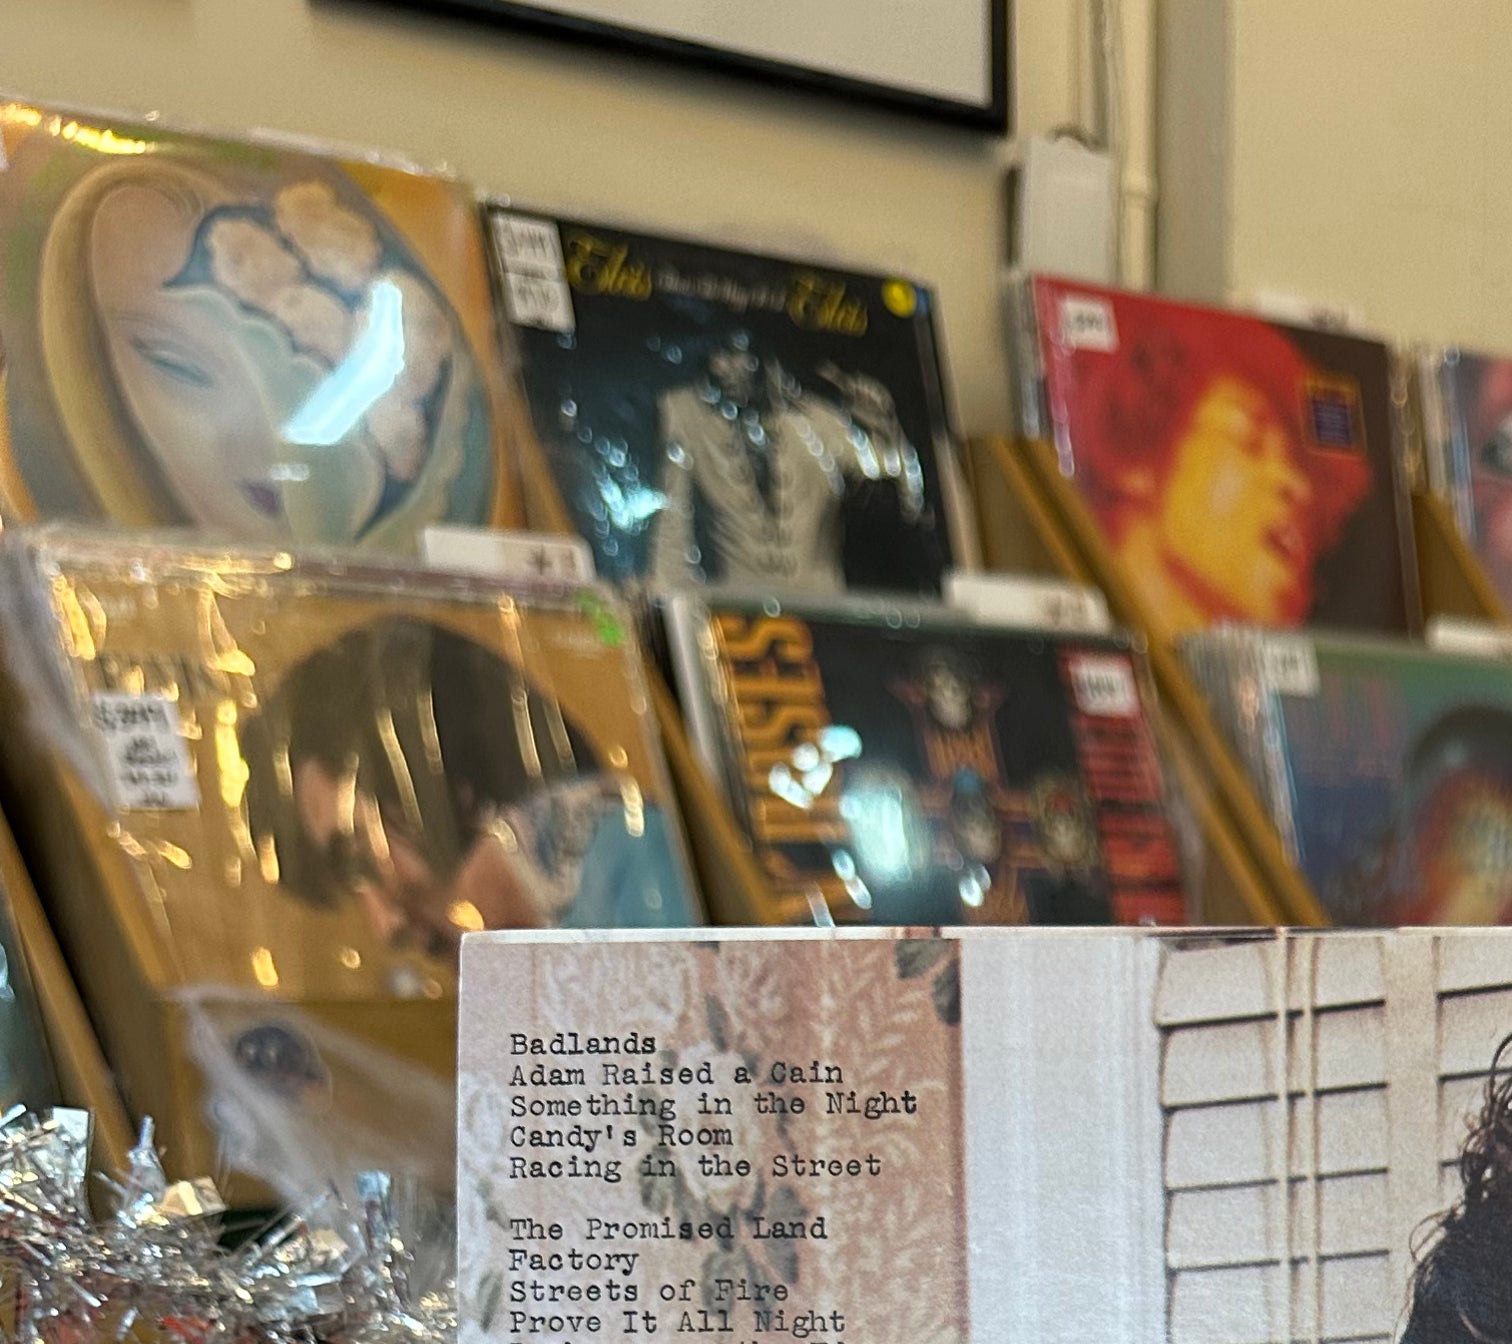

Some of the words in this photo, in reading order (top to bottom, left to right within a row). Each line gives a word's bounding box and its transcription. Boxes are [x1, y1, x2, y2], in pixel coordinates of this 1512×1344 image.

[511, 1032, 656, 1055] Badlands
[509, 1063, 585, 1086] Adam
[603, 1062, 714, 1085] Raised
[735, 1066, 751, 1084] a
[771, 1062, 844, 1084] Cain
[511, 1094, 675, 1119] Something
[698, 1093, 732, 1114] in
[755, 1092, 805, 1114] the
[827, 1091, 917, 1119] Night
[510, 1124, 637, 1151] Candy's
[659, 1124, 733, 1146] Room
[510, 1156, 621, 1182] Racing
[642, 1156, 675, 1177] in
[699, 1155, 751, 1177] the
[773, 1154, 881, 1176] Street
[510, 1218, 563, 1240] The
[586, 1217, 733, 1239] Promised
[754, 1216, 827, 1238] Land
[509, 1249, 638, 1275] Factory
[510, 1281, 638, 1302] Streets
[660, 1280, 696, 1302] of
[716, 1279, 789, 1301] Fire
[510, 1311, 601, 1333] Prove
[624, 1310, 657, 1333] It
[678, 1310, 734, 1332] All
[754, 1309, 845, 1337] Night
